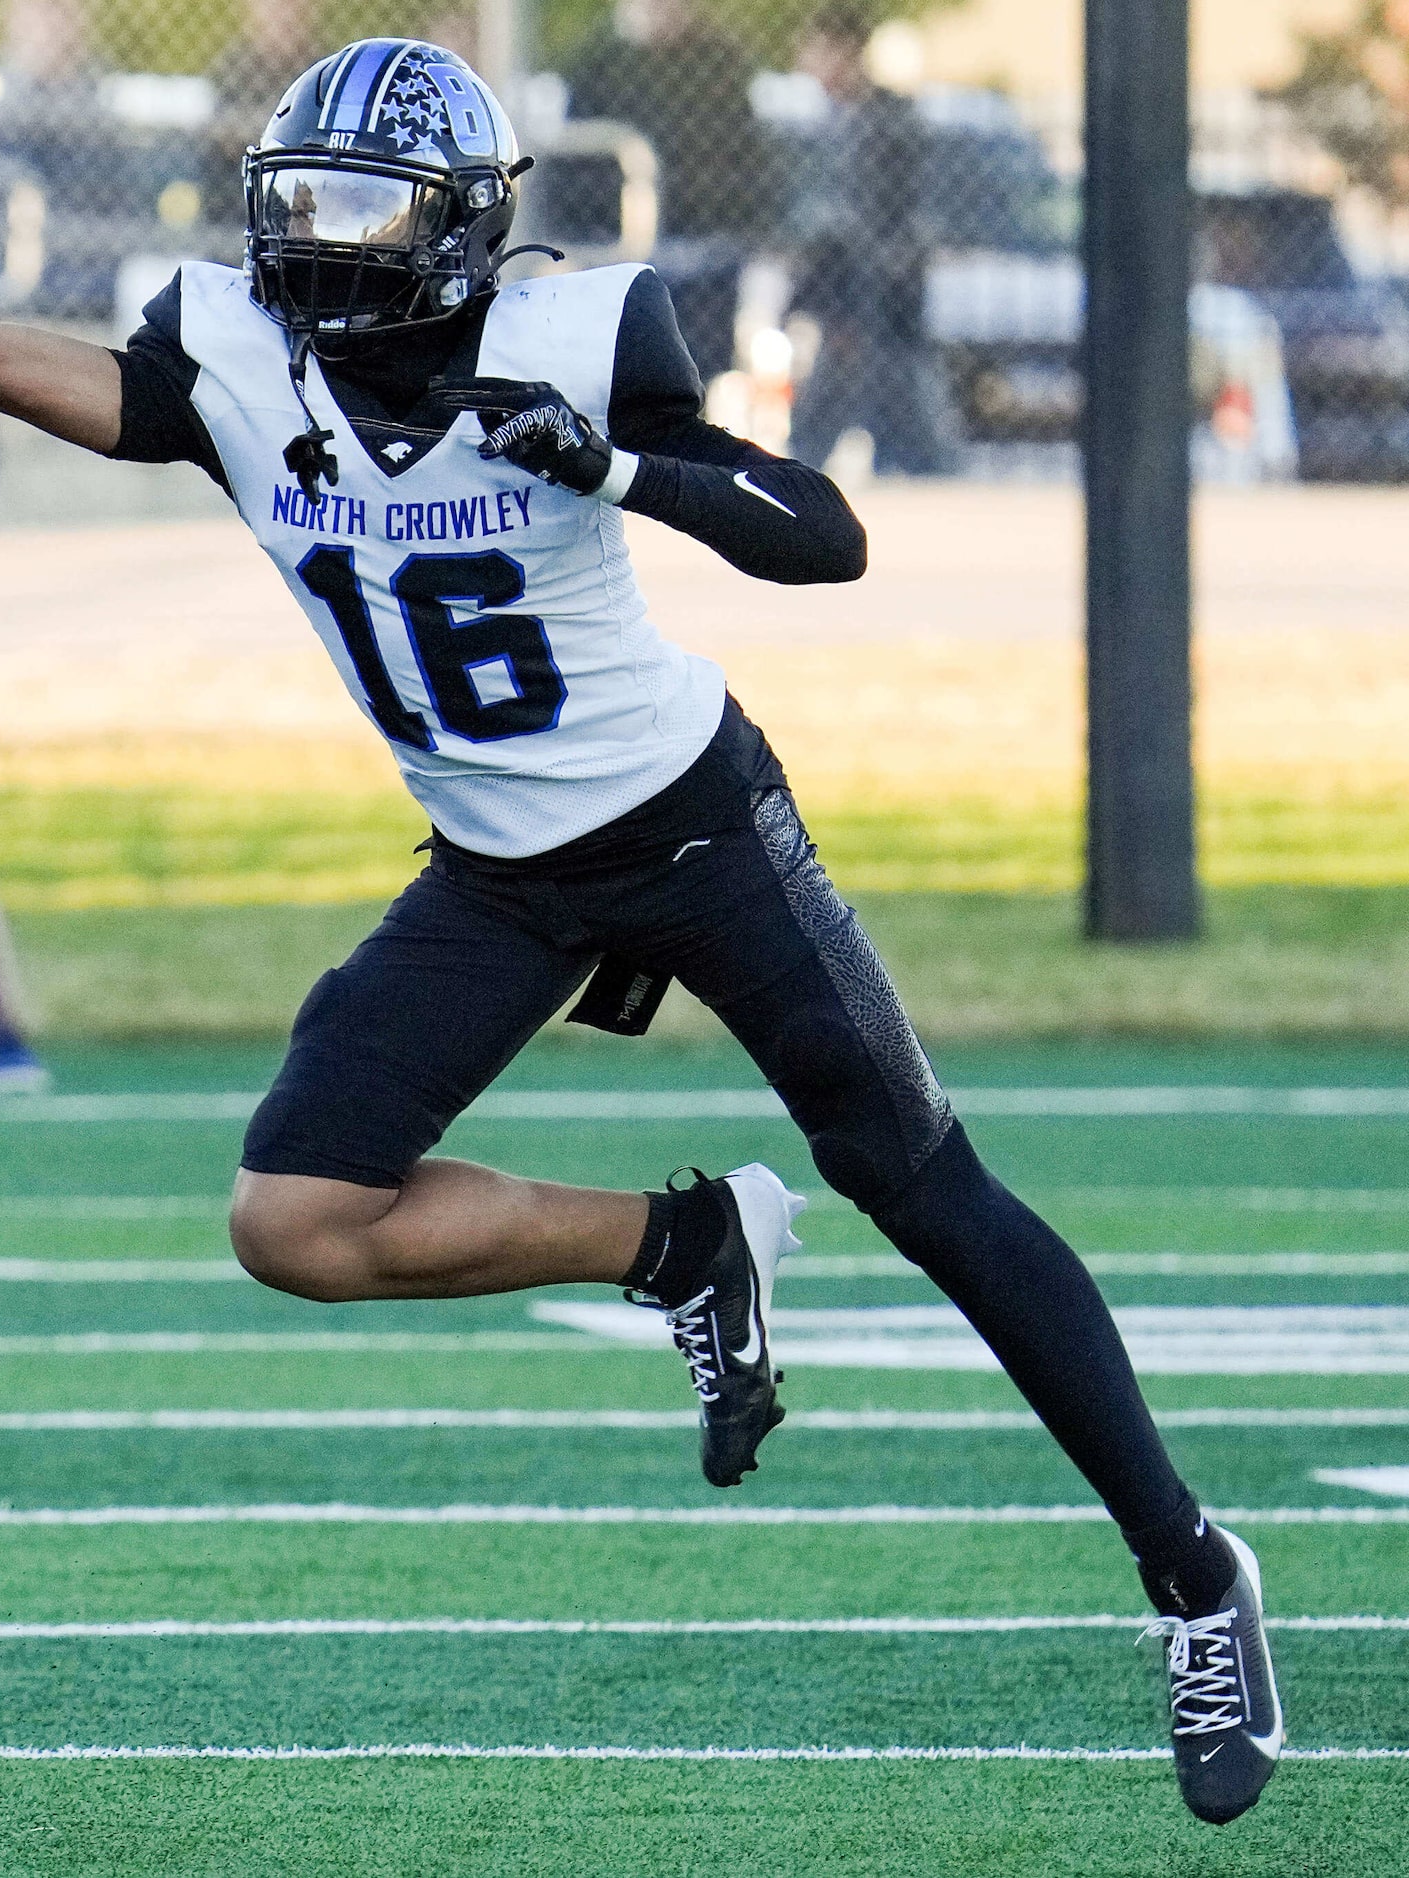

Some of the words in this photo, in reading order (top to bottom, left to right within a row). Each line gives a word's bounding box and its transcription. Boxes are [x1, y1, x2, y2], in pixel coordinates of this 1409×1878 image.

[273, 484, 366, 536] NORTH
[386, 486, 532, 541] CROWLEY
[295, 542, 569, 753] 16
